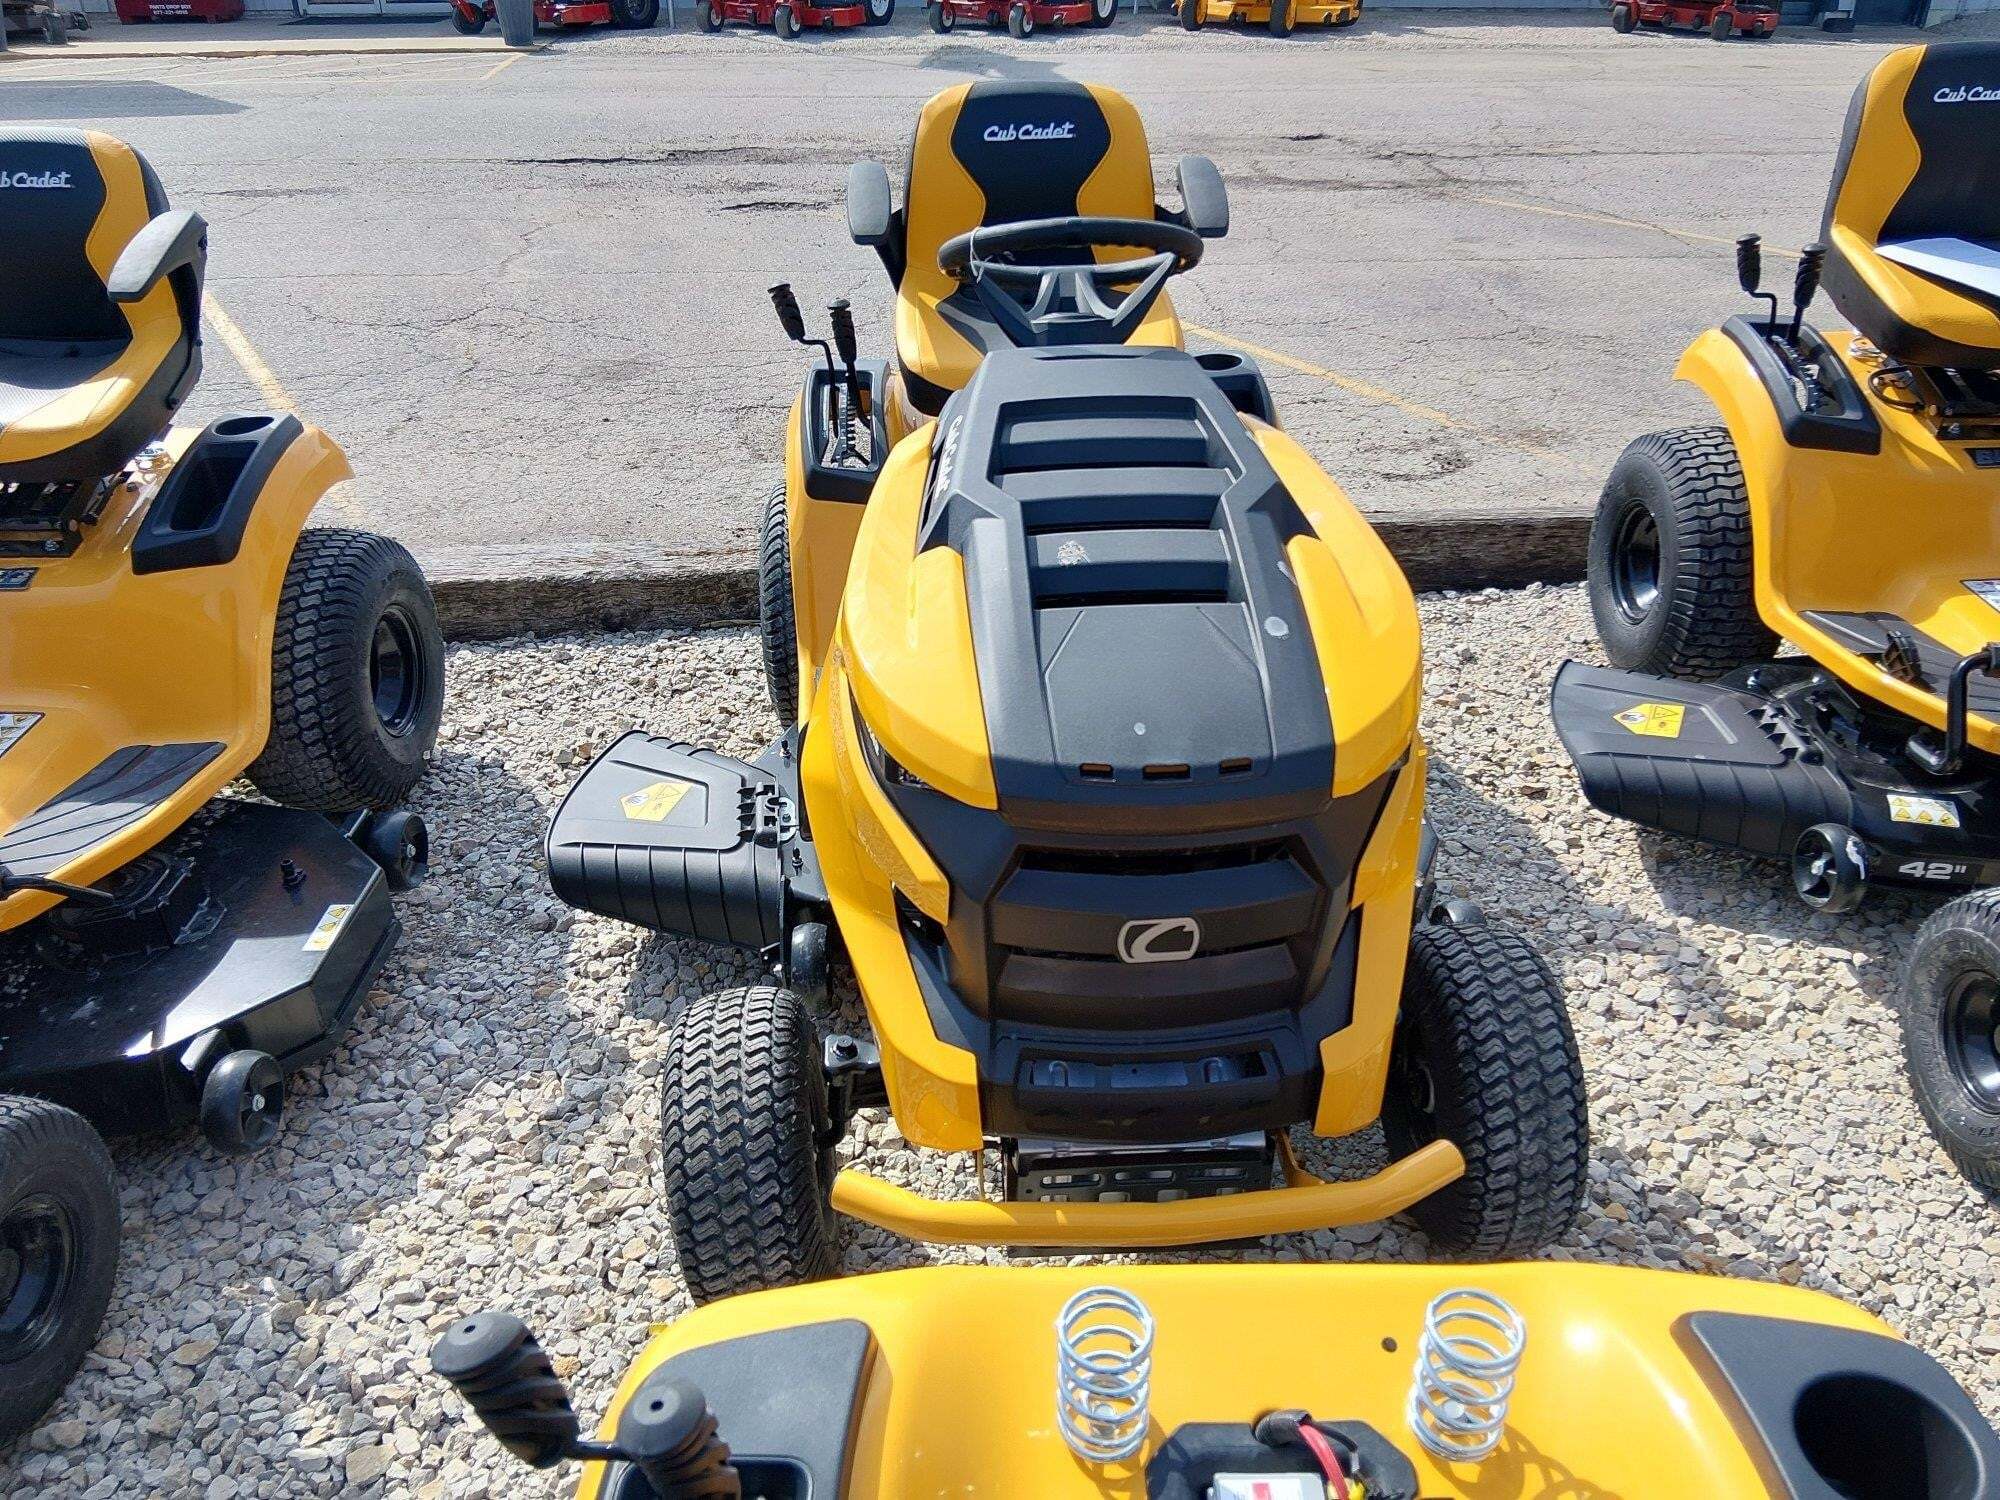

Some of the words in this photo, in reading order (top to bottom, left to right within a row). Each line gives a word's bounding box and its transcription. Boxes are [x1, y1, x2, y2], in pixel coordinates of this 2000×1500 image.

[1933, 86, 1967, 103] Cub
[983, 123, 1017, 141] Cub
[1018, 121, 1075, 140] Cadet
[12, 171, 71, 188] Cadet
[1898, 861, 1967, 880] 42"
